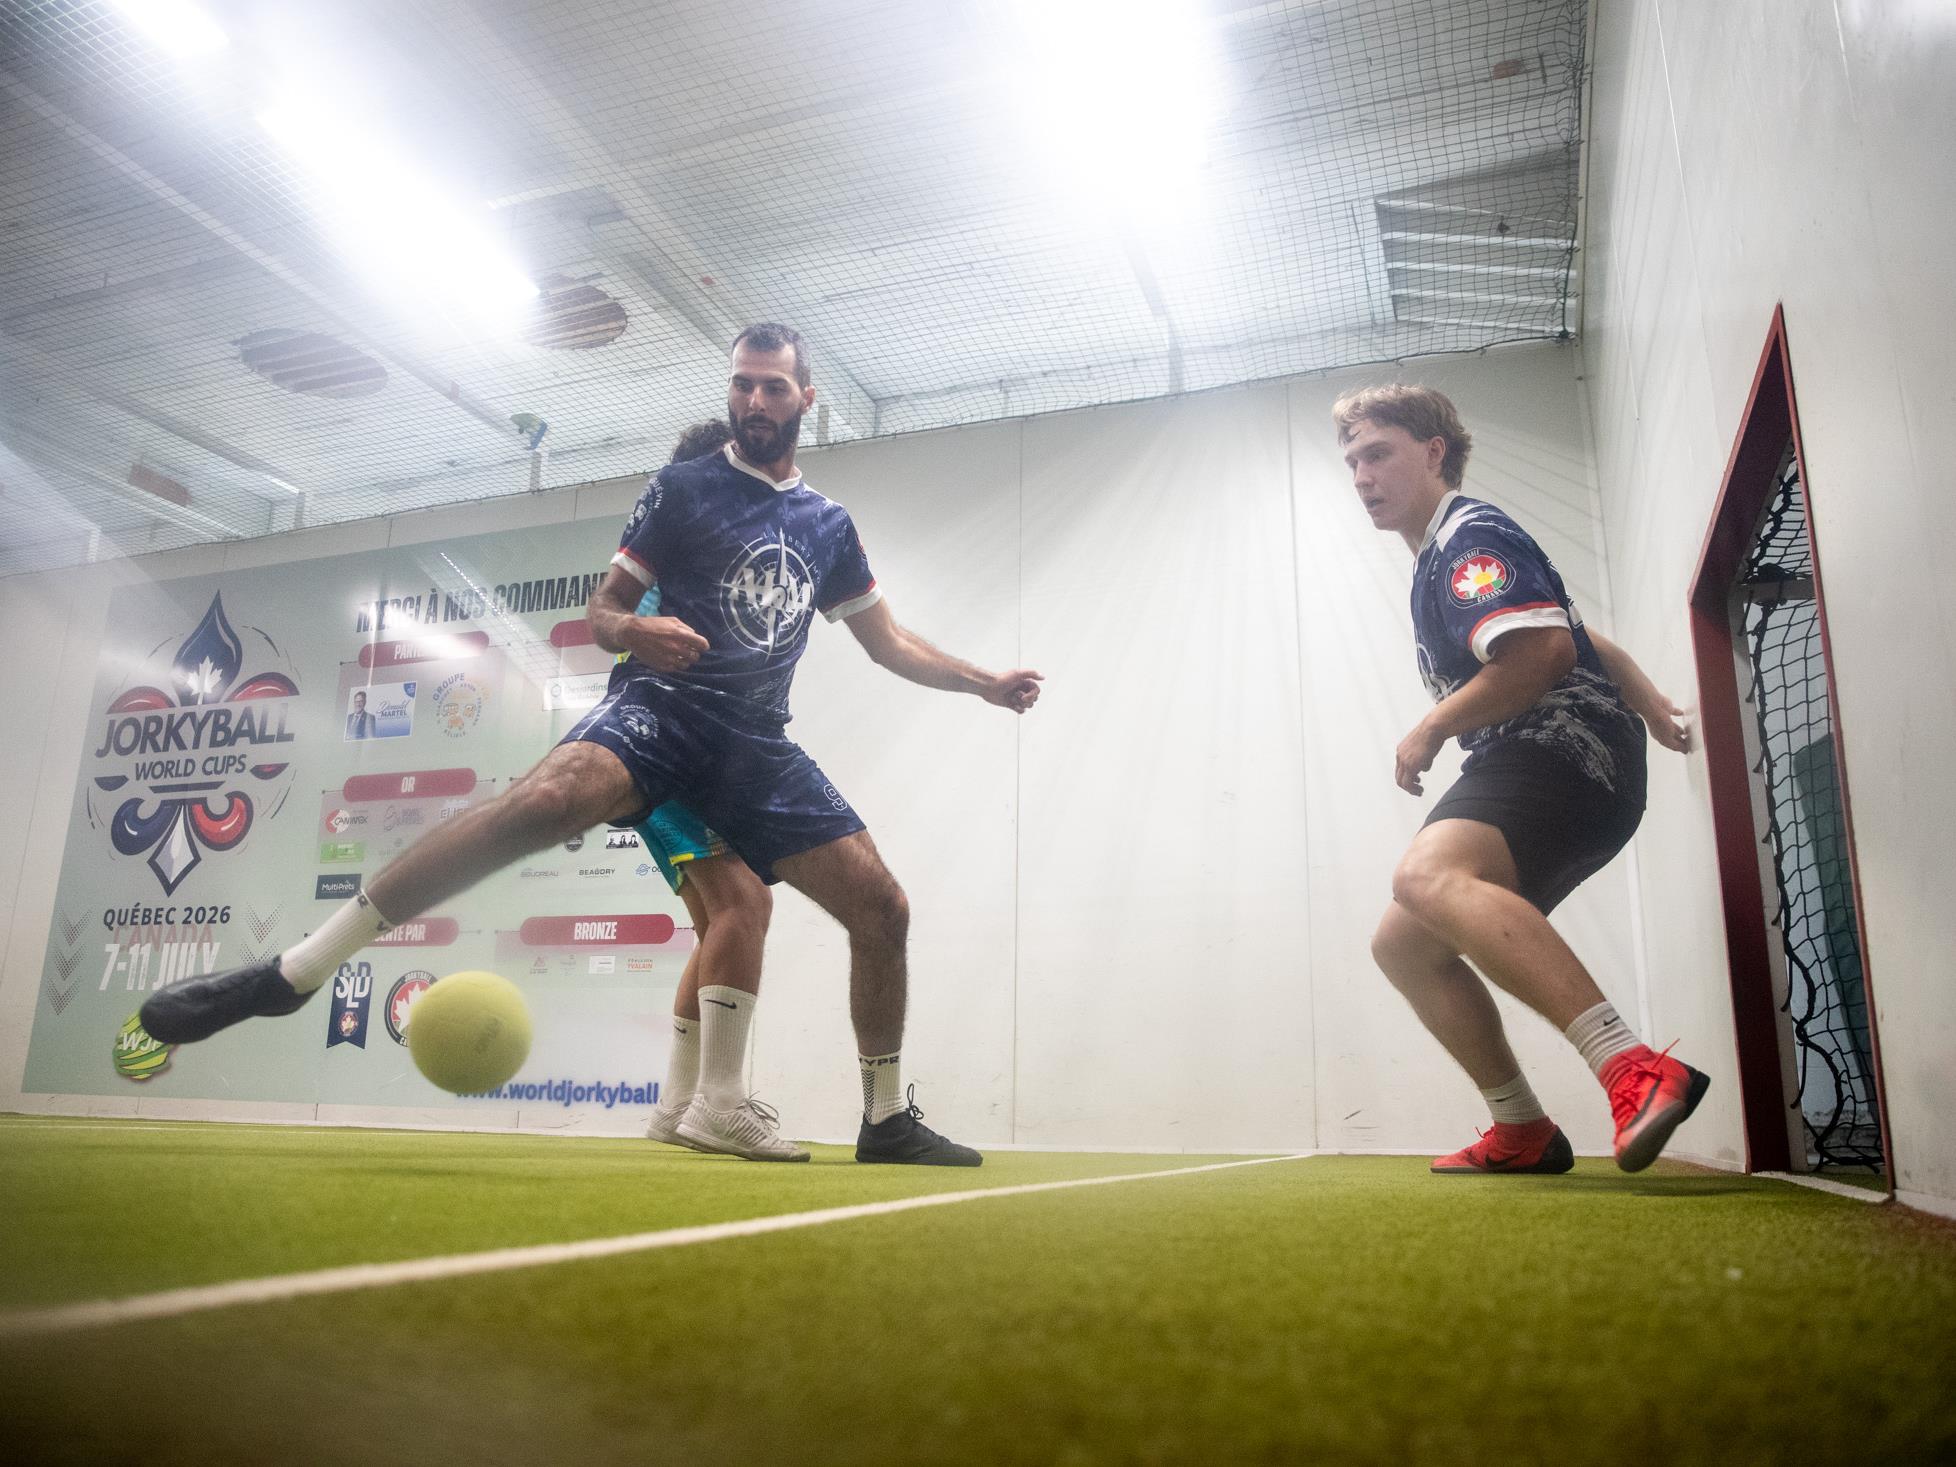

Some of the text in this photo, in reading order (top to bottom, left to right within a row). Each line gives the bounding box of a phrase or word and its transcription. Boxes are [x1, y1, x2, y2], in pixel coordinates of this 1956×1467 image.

[425, 588, 439, 625] À
[443, 585, 487, 622] NOS
[432, 672, 465, 701] GROUPE
[95, 702, 295, 758] JORKYBALL
[135, 753, 248, 781] WORLD CUPS
[402, 777, 416, 793] OR
[103, 902, 231, 931] QUÉBEC 2026
[573, 921, 618, 940] BRONZE
[404, 924, 426, 941] PAR
[99, 943, 152, 991] 7-11
